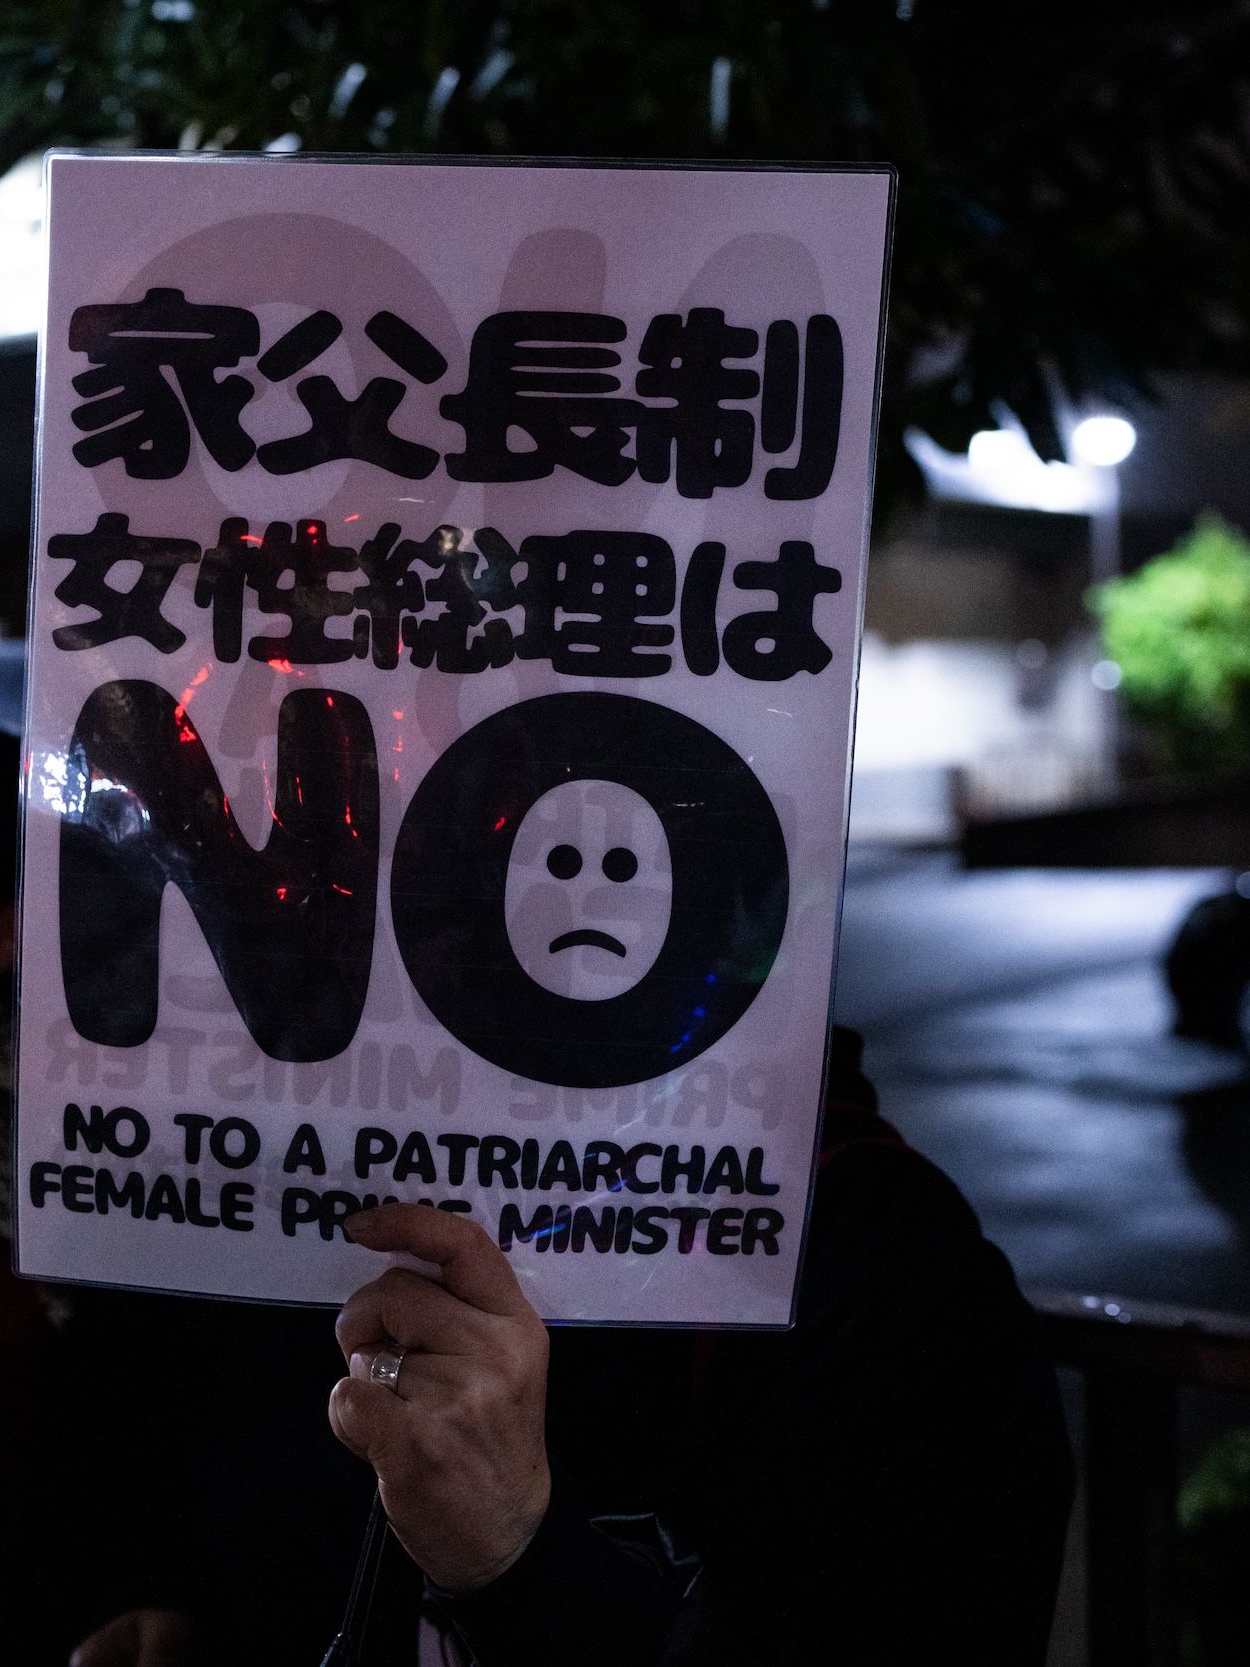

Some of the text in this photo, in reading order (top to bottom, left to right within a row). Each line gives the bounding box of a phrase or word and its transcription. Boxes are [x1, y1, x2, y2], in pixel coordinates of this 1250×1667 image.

[67, 287, 844, 500] 家父長制
[47, 512, 843, 681] 女性総理は
[58, 679, 790, 1089] NO
[30, 1161, 255, 1232] FEMALE
[498, 1203, 785, 1256] MINISTER
[63, 1103, 780, 1196] NO TO A PATRIARCHAL
